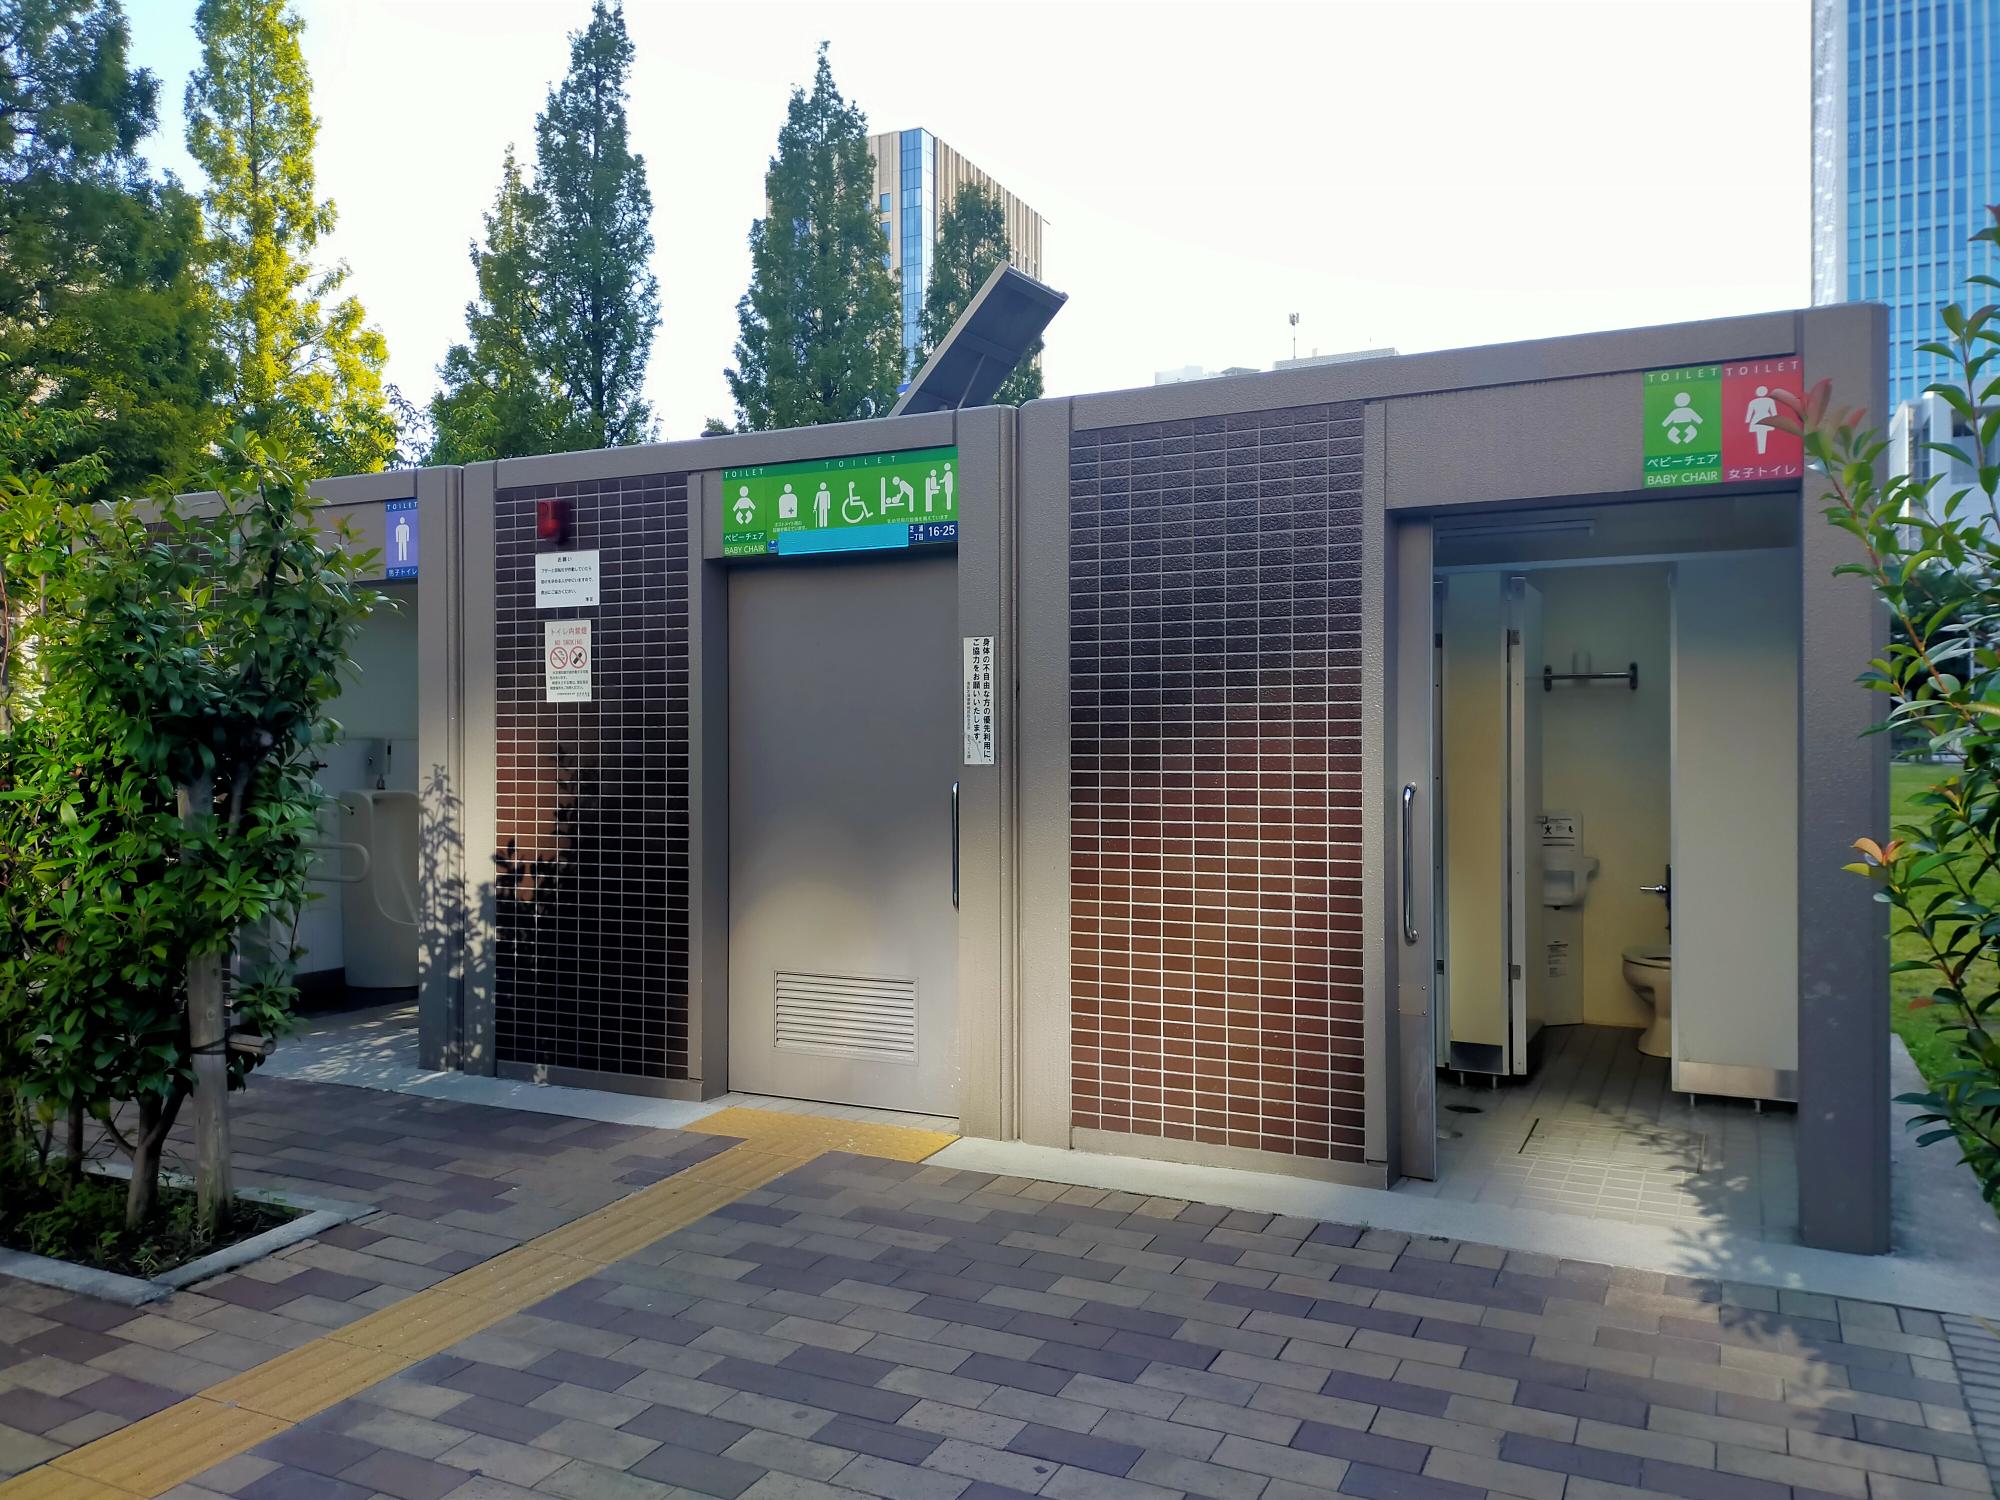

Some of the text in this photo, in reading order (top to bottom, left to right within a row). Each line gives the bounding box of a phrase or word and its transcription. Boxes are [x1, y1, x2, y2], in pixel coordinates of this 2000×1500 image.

[1648, 367, 1718, 383] TOILET
[1725, 360, 1799, 377] TOILET
[825, 455, 896, 469] TOILET
[724, 468, 764, 479] TOILET
[1647, 470, 1719, 486] BABY CHAIR
[1728, 464, 1797, 480] 女子トイレ
[386, 501, 418, 511] TOILET
[928, 524, 955, 537] 16-25
[724, 544, 765, 555] BABY CHAIR
[388, 568, 418, 578] 男子トイレ
[972, 638, 982, 744] ご協力をお願いいたします。
[982, 637, 992, 762] 身体の不自由な方の優先利用に、
